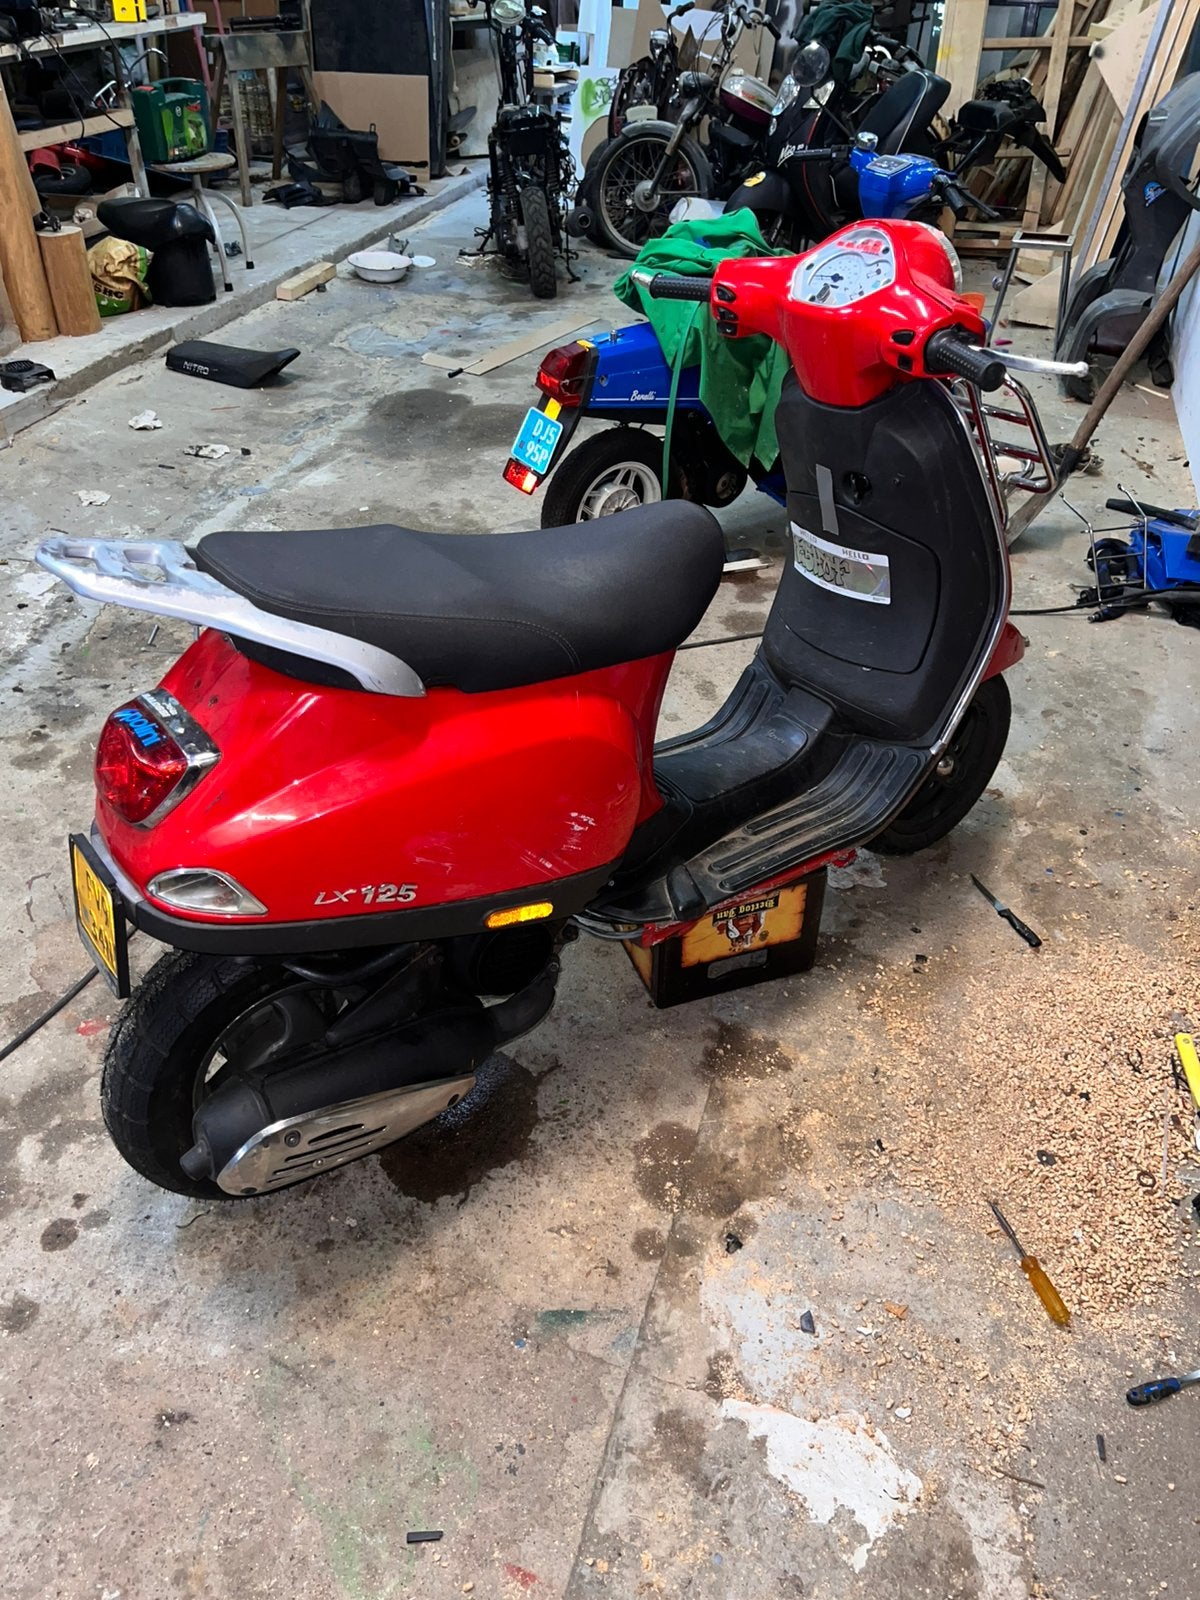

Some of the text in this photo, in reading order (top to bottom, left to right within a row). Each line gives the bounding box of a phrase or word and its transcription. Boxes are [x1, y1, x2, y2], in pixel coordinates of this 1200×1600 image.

[183, 361, 210, 375] NITRO
[630, 389, 657, 402] Benelli
[525, 440, 549, 466] 95P
[841, 548, 869, 561] HELLO
[313, 883, 418, 905] LX 125
[716, 899, 776, 919] Hertog Jan
